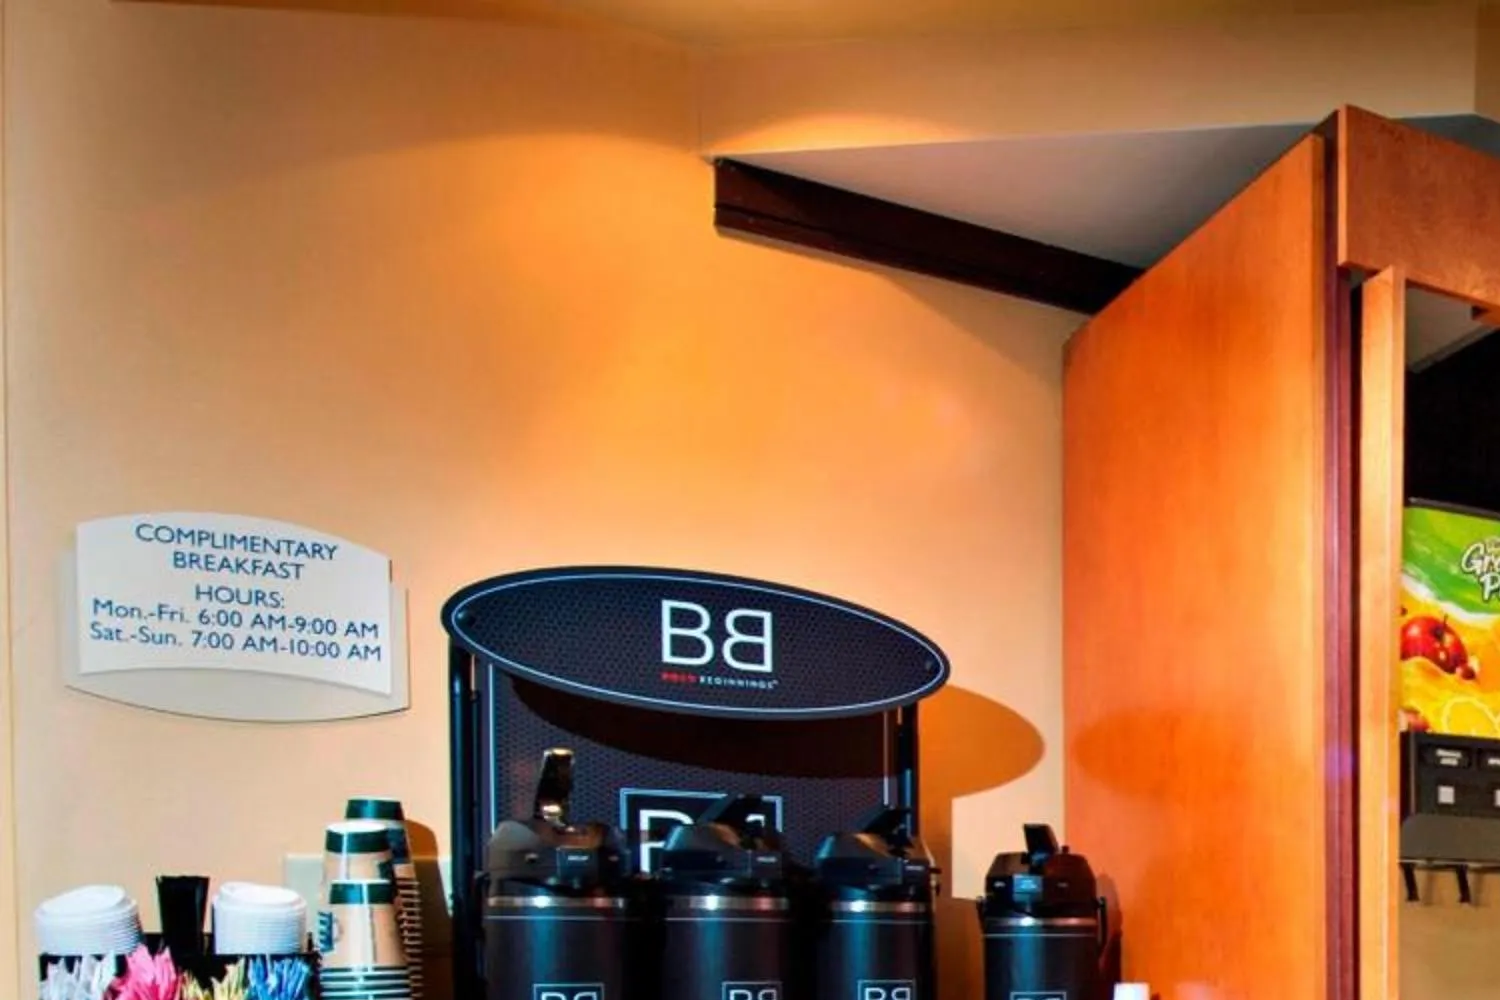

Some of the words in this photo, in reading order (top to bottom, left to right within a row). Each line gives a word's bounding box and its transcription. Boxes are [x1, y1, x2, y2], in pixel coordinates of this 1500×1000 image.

[135, 523, 338, 561] COMPLIMENTARY
[172, 550, 305, 580] BREAKFAST
[194, 584, 285, 609] HOURS:
[197, 607, 243, 629] 6:00
[343, 620, 379, 639] AM
[191, 629, 235, 651] 7:00
[346, 643, 382, 661] AM
